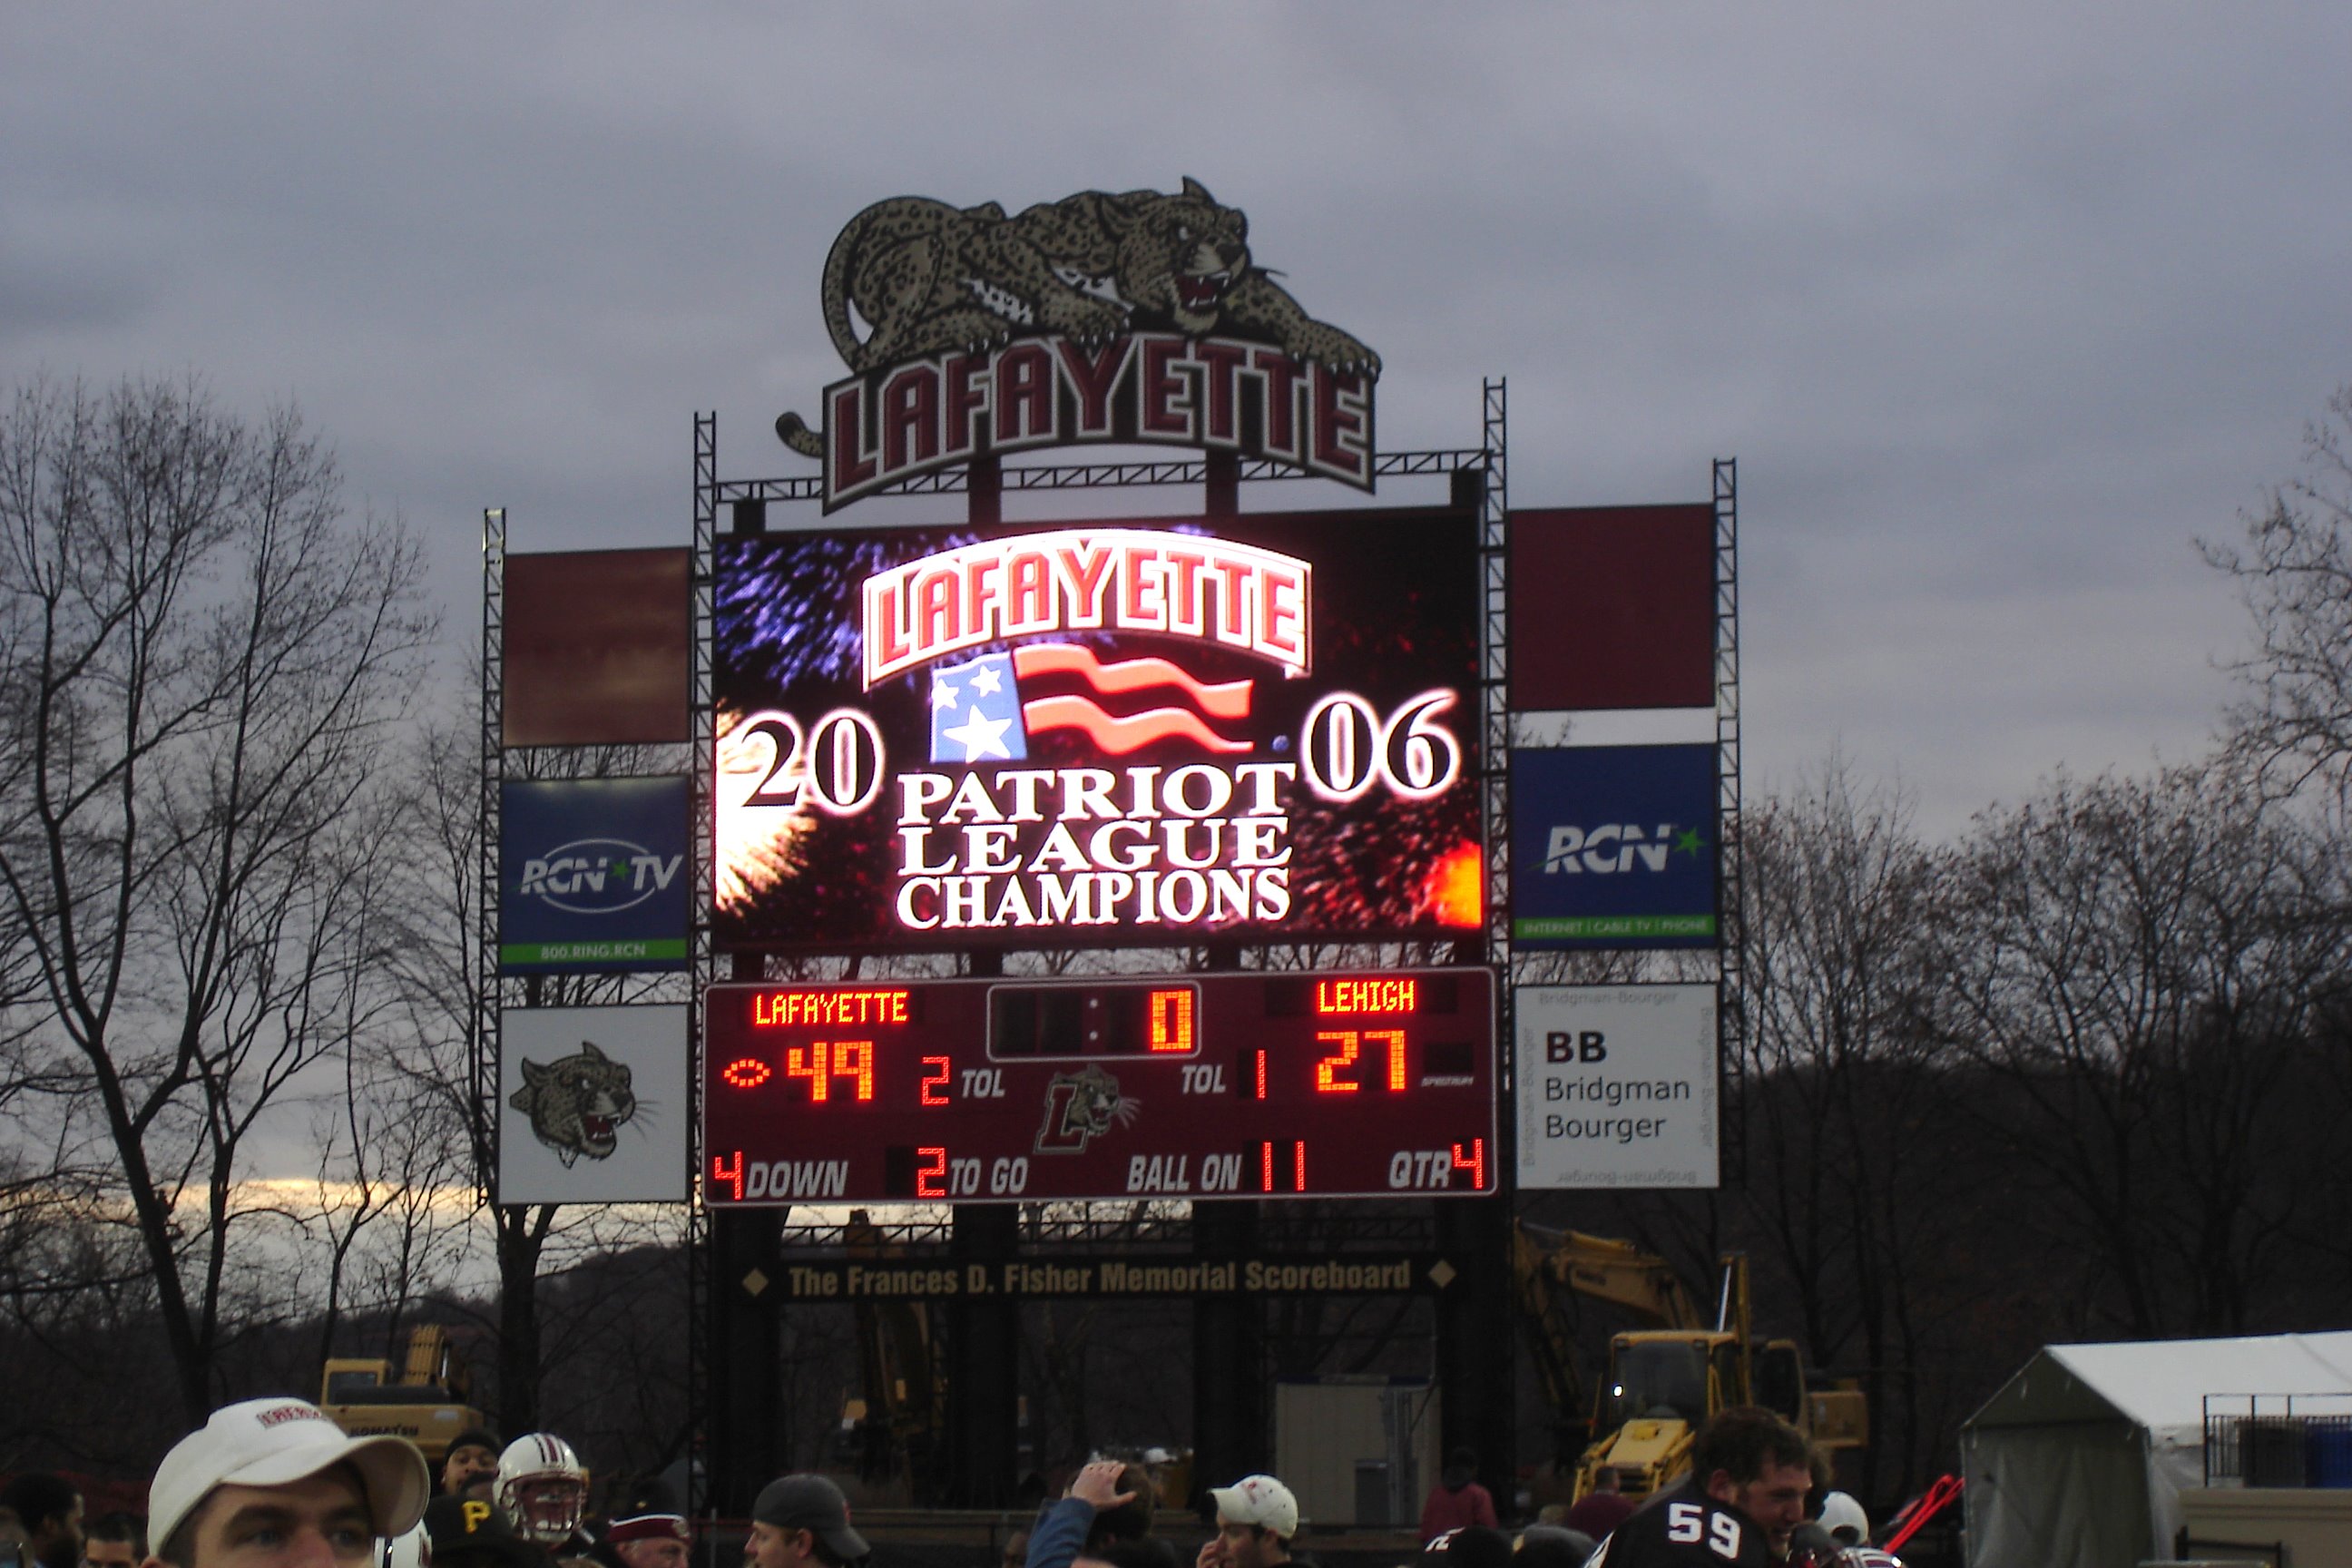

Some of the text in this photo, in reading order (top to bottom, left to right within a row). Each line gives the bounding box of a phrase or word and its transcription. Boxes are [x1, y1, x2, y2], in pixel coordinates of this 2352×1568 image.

[829, 332, 1369, 497] LAFAYETTE
[873, 537, 1302, 673] LAFAYETTE
[737, 712, 883, 810] 20
[1305, 691, 1458, 799] 06
[897, 762, 1297, 826] PATRIOT
[897, 817, 1293, 877] LEAGUE
[1544, 822, 1672, 874] RCN
[520, 854, 683, 895] RCN TV
[897, 867, 1292, 929] CHAMPIONS
[1524, 918, 1708, 934] INTERNET CABLE TV PHONE
[541, 942, 647, 961] 800.RING.RCN
[756, 992, 907, 1024] LAFAYETTE
[1152, 990, 1192, 1051] 0
[1318, 980, 1416, 1014] LEHIGH
[788, 1041, 873, 1101] 49
[1318, 1030, 1406, 1091] 27
[1546, 1031, 1607, 1063] BB
[922, 1056, 1005, 1104] 2 TOL
[1182, 1064, 1227, 1094] TOL
[1545, 1076, 1690, 1107] Bridgman
[1545, 1114, 1668, 1144] Bourger
[714, 1152, 848, 1200] 4 DOWN
[917, 1148, 1029, 1197] 2 TO GO
[1127, 1155, 1191, 1192] BALL
[1200, 1153, 1243, 1191] ON
[1388, 1139, 1484, 1190] QTR 4
[789, 1259, 1412, 1296] The Frances D. Fisher Memorial Scoreboard
[349, 1425, 419, 1437] KOMATSU
[462, 1500, 491, 1534] P
[1668, 1502, 1740, 1559] 59
